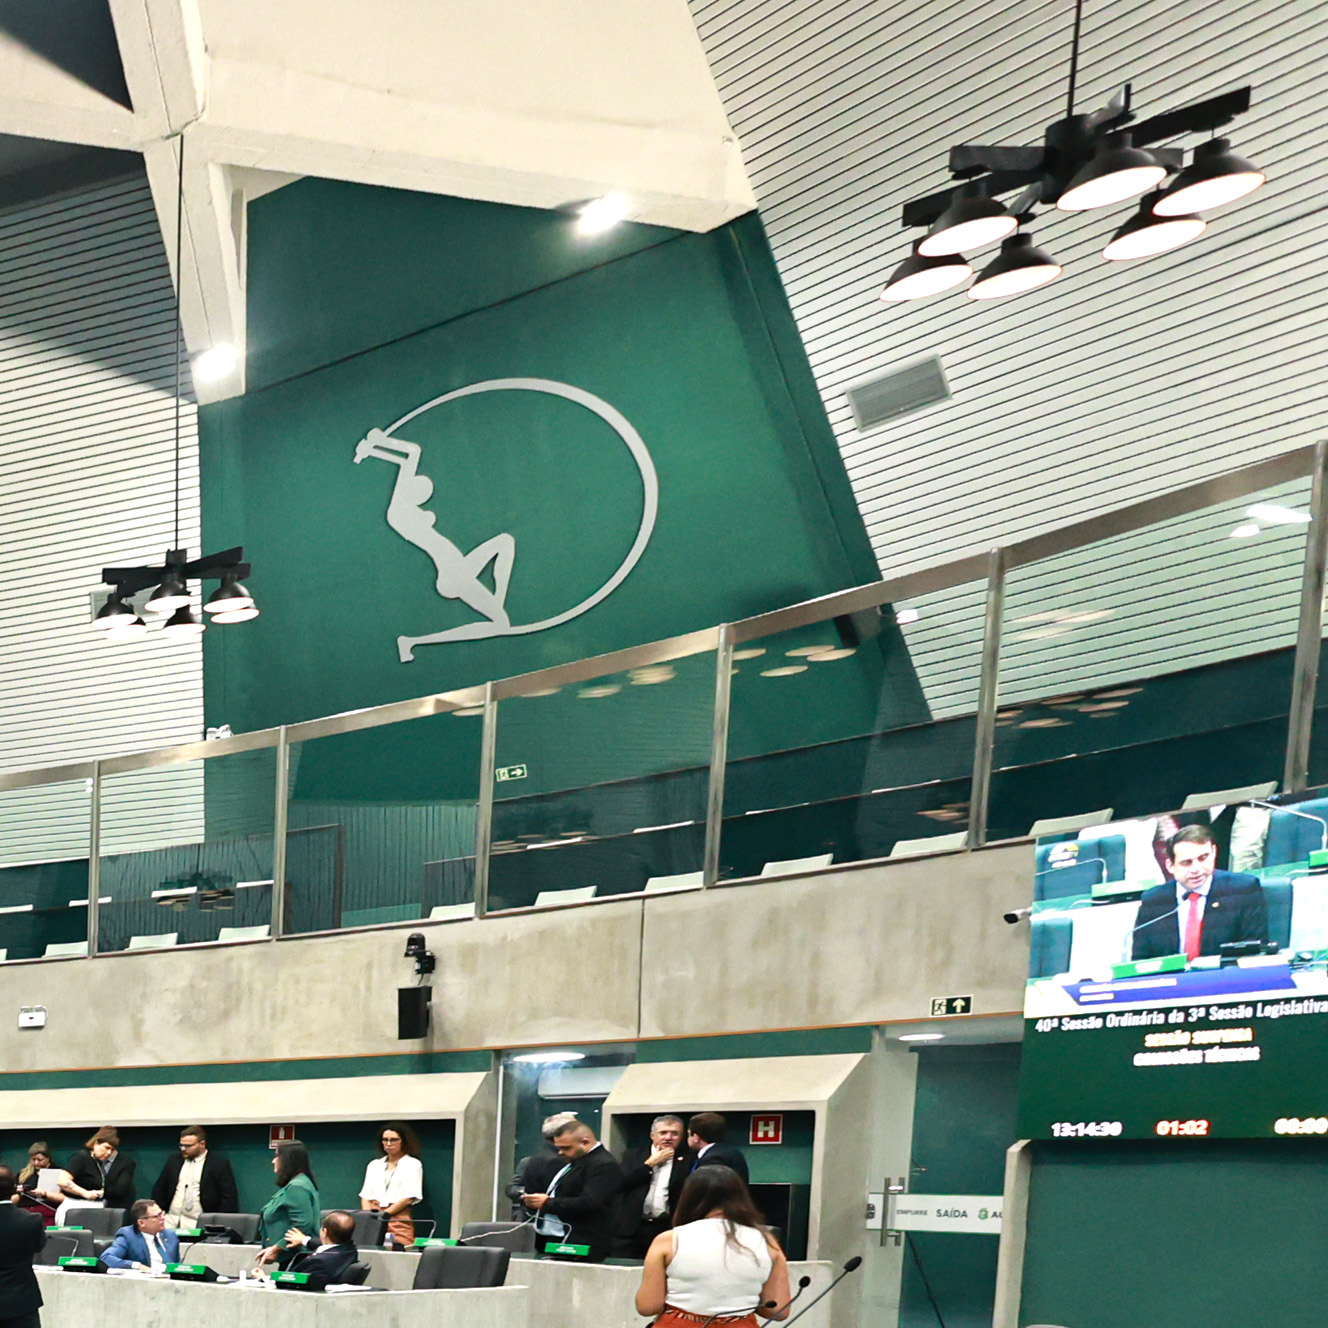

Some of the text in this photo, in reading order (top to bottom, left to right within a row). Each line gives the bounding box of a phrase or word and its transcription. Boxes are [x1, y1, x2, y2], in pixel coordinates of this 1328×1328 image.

[1061, 1014, 1103, 1031] Sessão
[1105, 1009, 1165, 1027] Ordinária
[1168, 1008, 1185, 1023] da
[1187, 1007, 1206, 1022] 3ª
[1208, 1003, 1253, 1020] Sessão
[1256, 997, 1328, 1018] Legislativa
[1155, 1119, 1210, 1136] 01:02
[936, 1208, 968, 1218] SAÍDA
